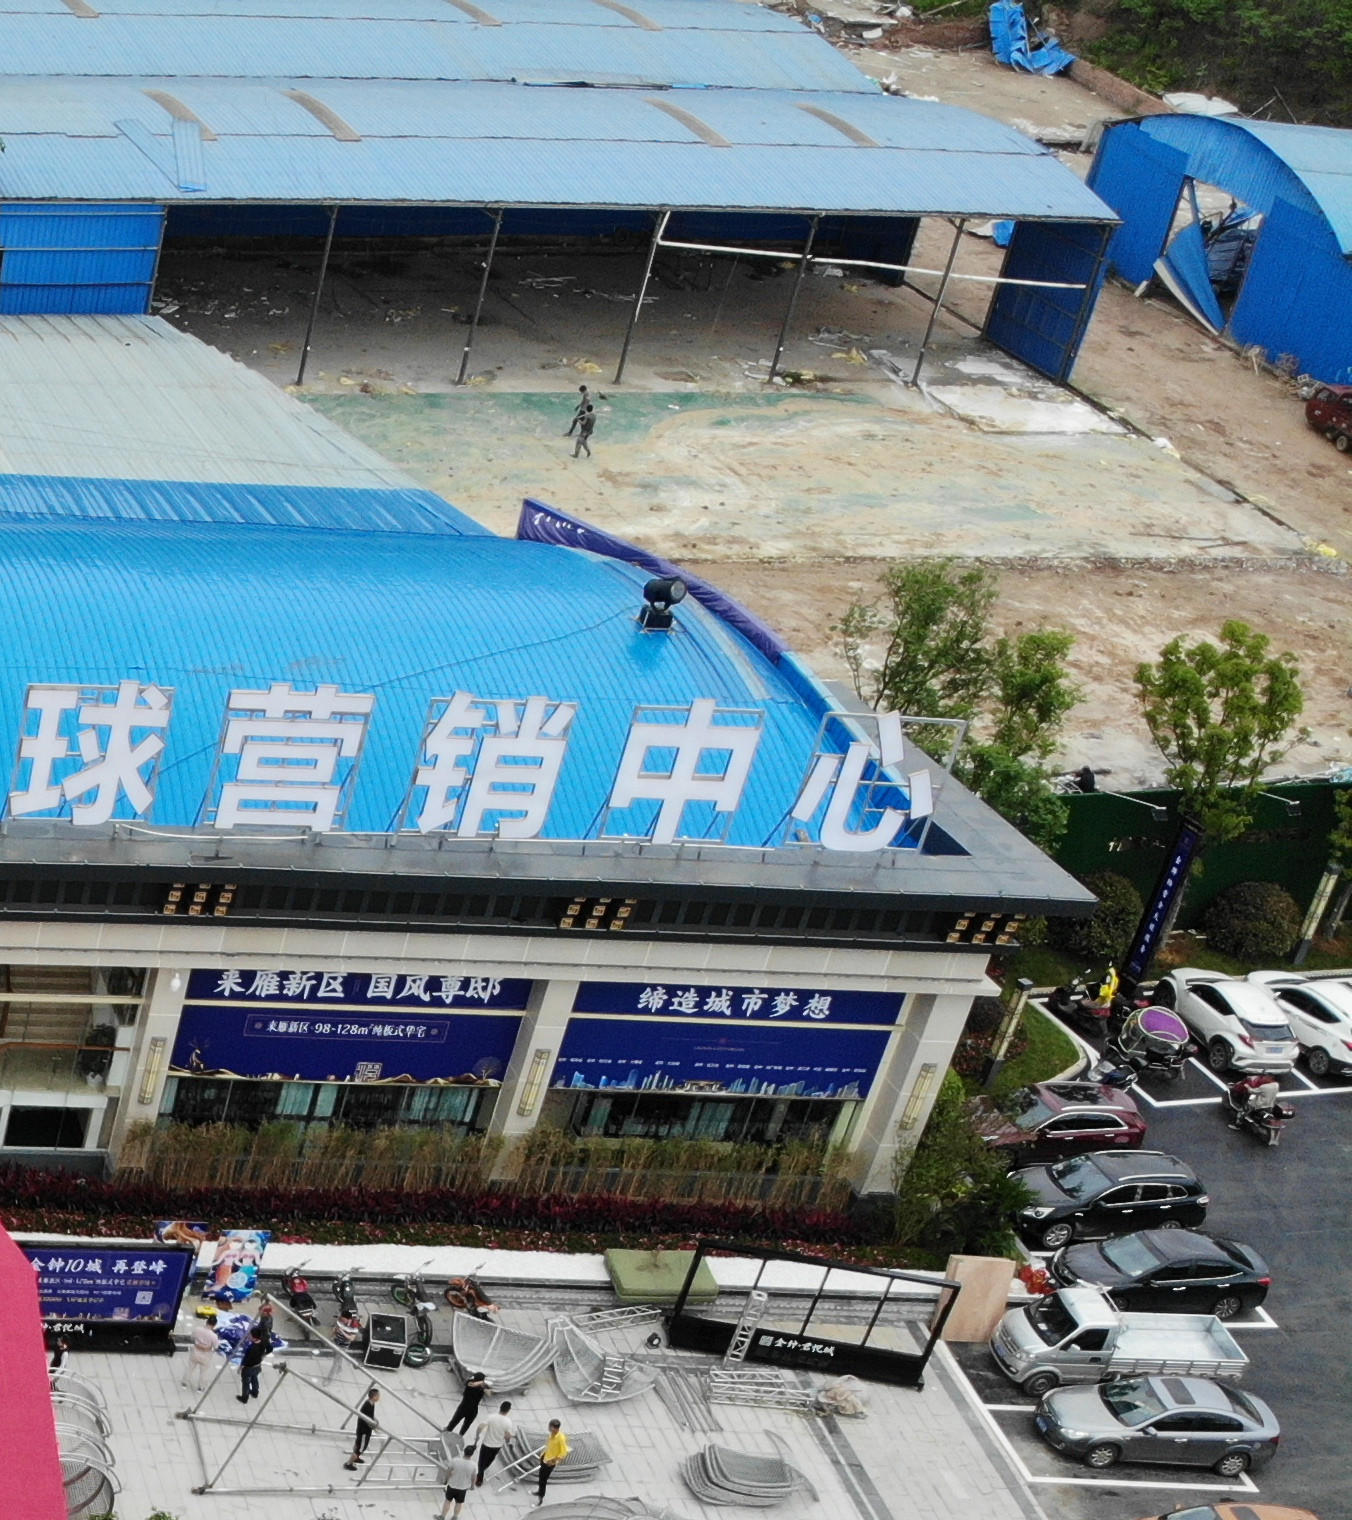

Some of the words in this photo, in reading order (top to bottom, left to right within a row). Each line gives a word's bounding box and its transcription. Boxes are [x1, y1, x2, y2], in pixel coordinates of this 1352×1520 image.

[213, 970, 348, 1000] 来雁新区
[637, 986, 833, 1019] 缔造城市梦想
